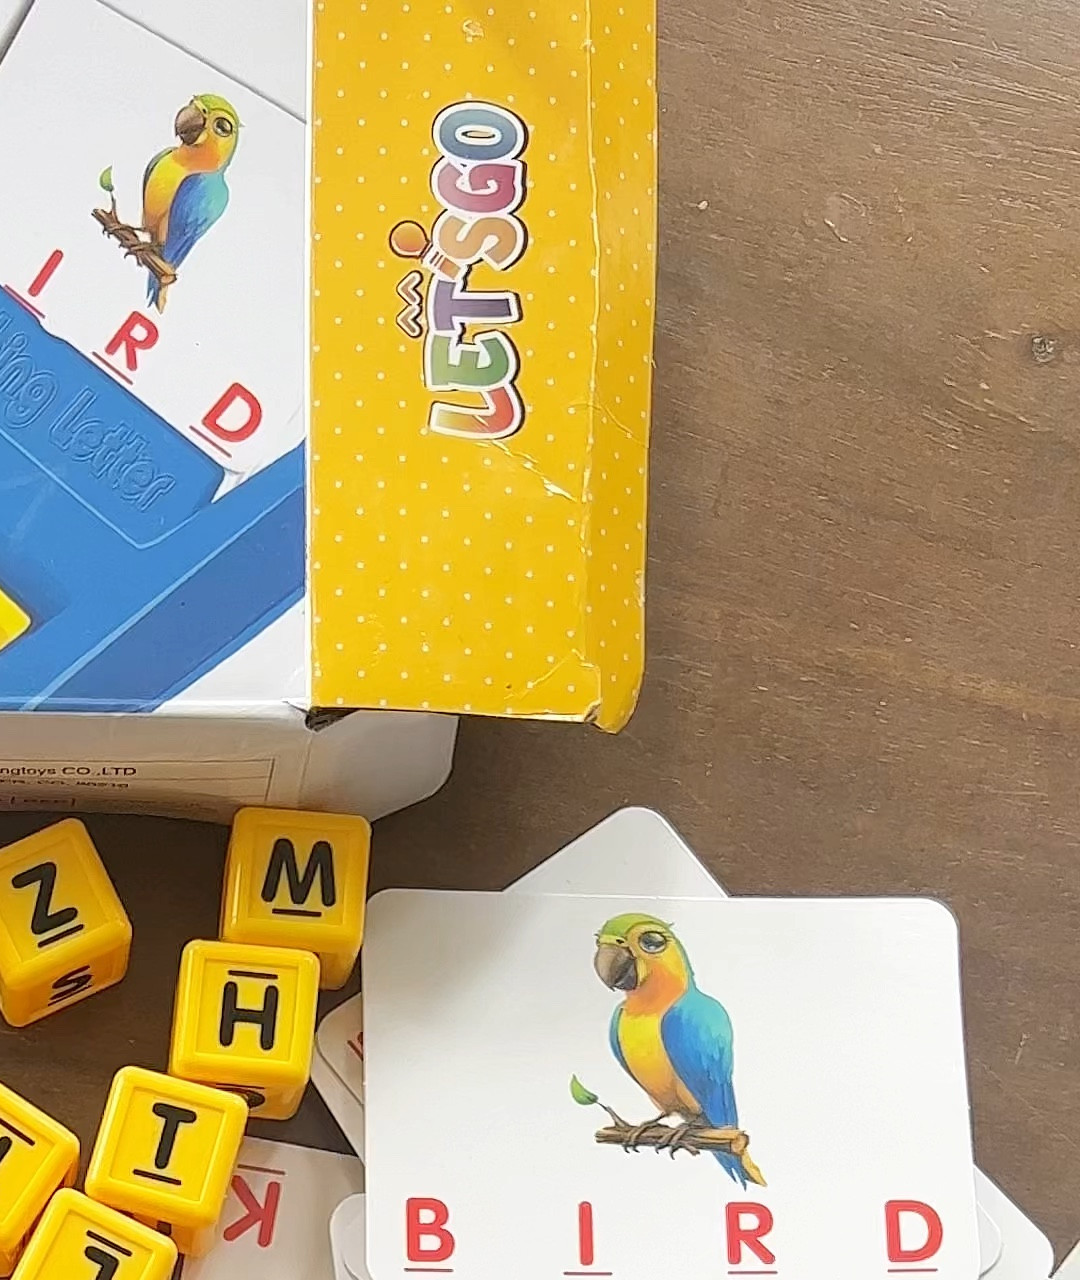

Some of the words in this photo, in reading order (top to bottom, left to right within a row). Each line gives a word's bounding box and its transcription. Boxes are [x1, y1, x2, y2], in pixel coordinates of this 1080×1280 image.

[11, 861, 78, 936] Z
[261, 838, 336, 907] M
[219, 981, 279, 1050] H
[153, 1102, 197, 1169] T
[223, 1174, 281, 1248] K
